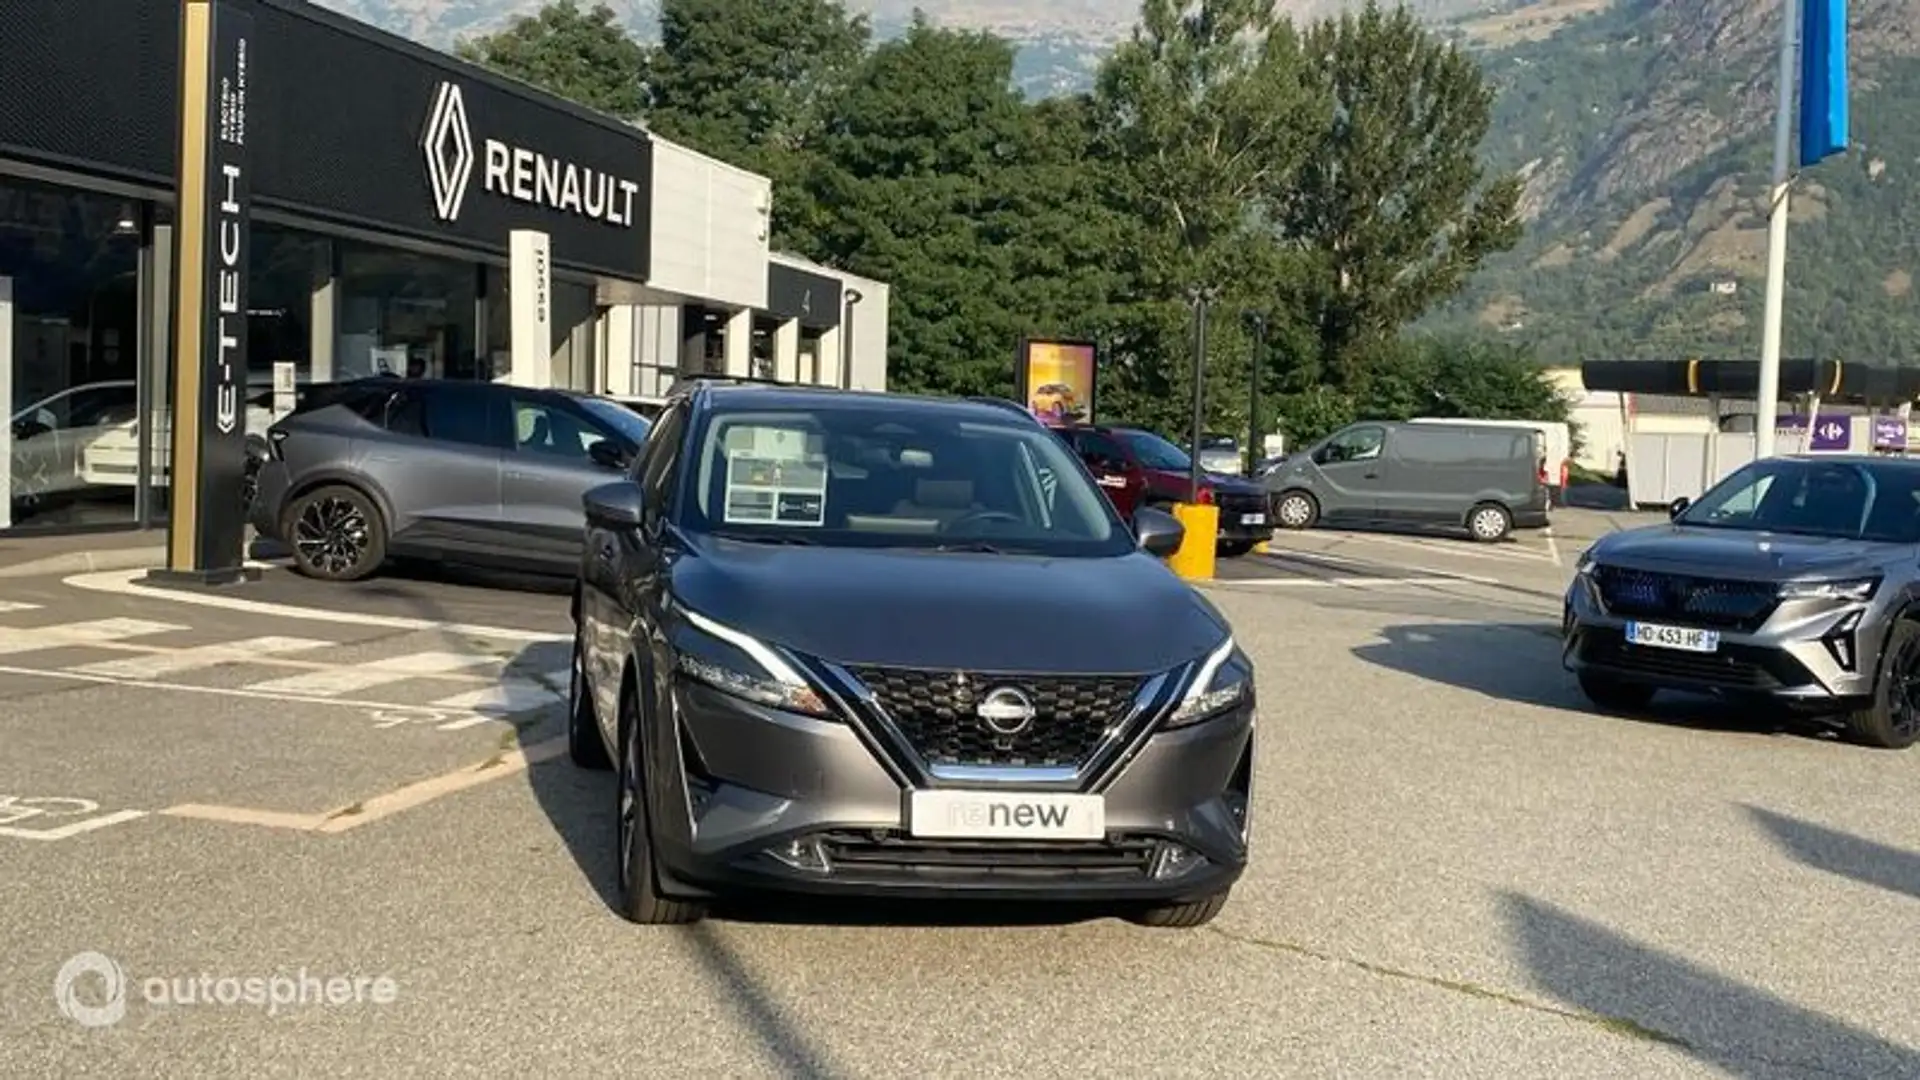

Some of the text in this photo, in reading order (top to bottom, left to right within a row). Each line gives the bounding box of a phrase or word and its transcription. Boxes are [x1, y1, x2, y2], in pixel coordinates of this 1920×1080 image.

[484, 138, 638, 227] RENAULT
[217, 164, 240, 433] E-TECH
[952, 802, 1069, 828] renew
